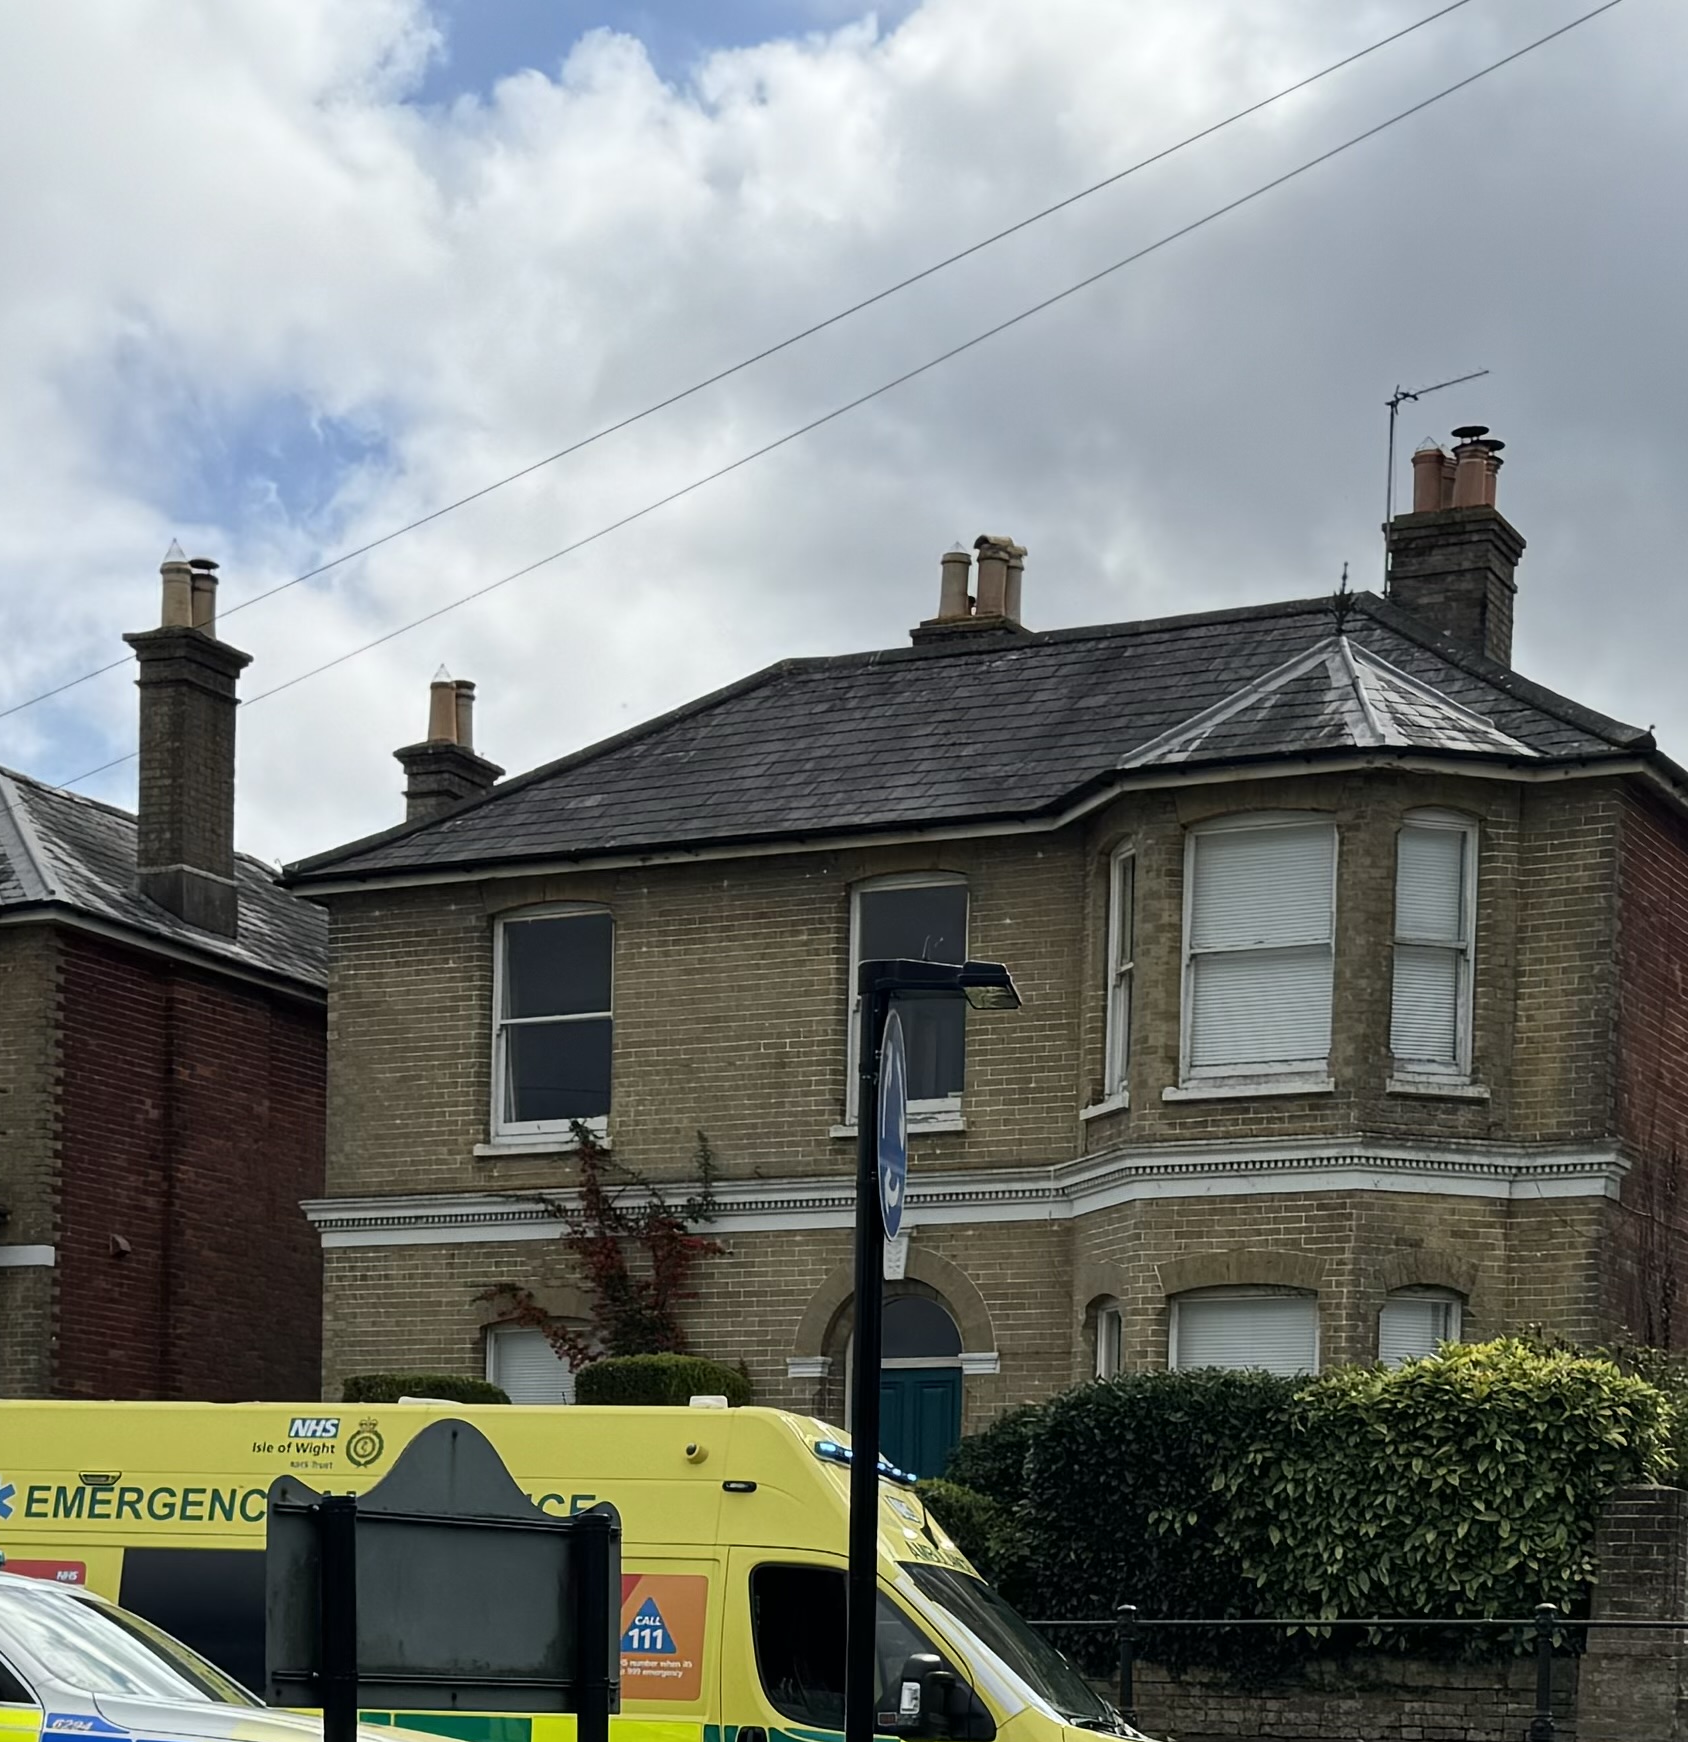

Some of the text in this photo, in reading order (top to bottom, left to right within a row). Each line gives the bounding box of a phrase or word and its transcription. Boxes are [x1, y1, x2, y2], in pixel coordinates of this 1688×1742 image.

[289, 1419, 339, 1437] NHS
[252, 1441, 336, 1457] Isle of Wight
[24, 1485, 266, 1523] EMERGENC
[56, 1570, 79, 1581] NHS
[634, 1615, 662, 1626] CALL
[628, 1628, 663, 1650] 111
